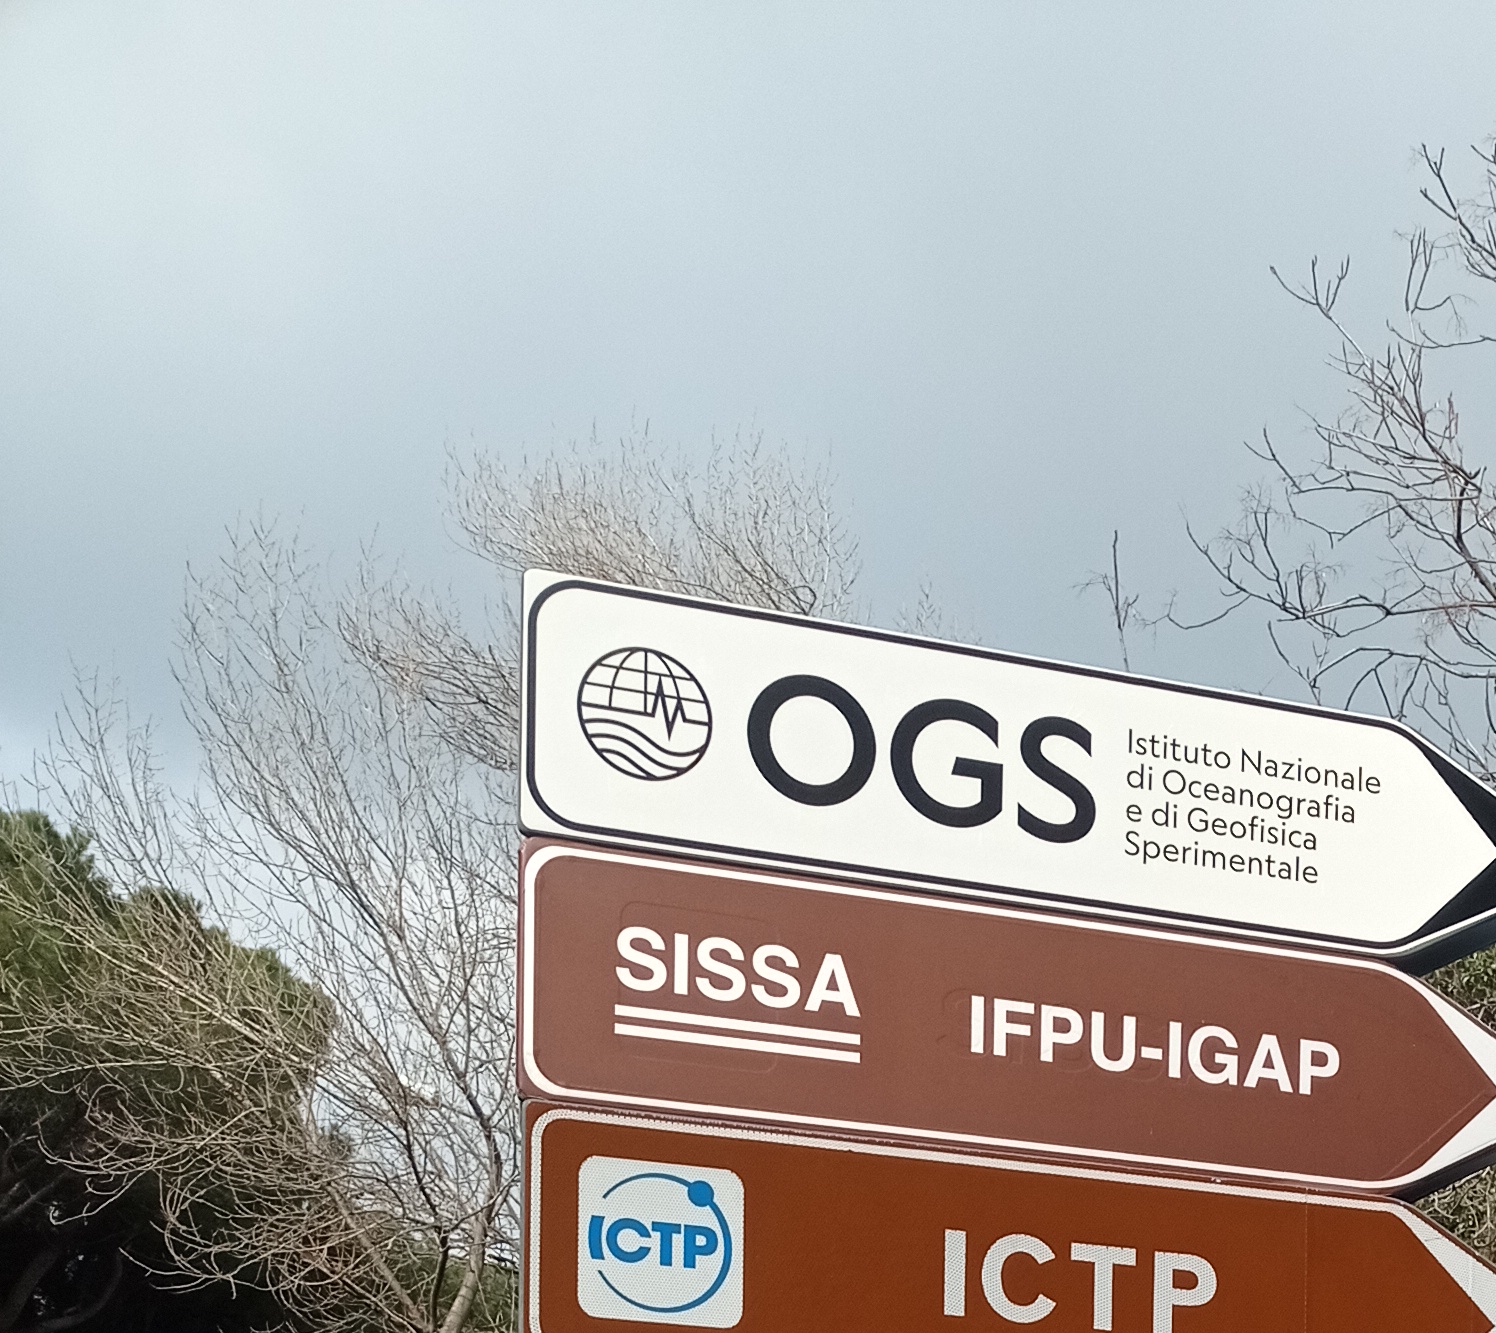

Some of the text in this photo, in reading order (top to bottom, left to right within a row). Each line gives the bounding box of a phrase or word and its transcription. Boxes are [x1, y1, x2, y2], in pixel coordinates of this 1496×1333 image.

[747, 673, 1097, 844] OGS
[1127, 728, 1381, 794] Istituto Nazionale
[1126, 763, 1355, 823] di Oceanografia
[1124, 830, 1319, 884] Sperimentale
[1125, 801, 1317, 850] e di Geofisica
[614, 926, 861, 1018] SISSA
[970, 995, 1341, 1096] IFPU-IGAP
[588, 1214, 719, 1269] ICTP
